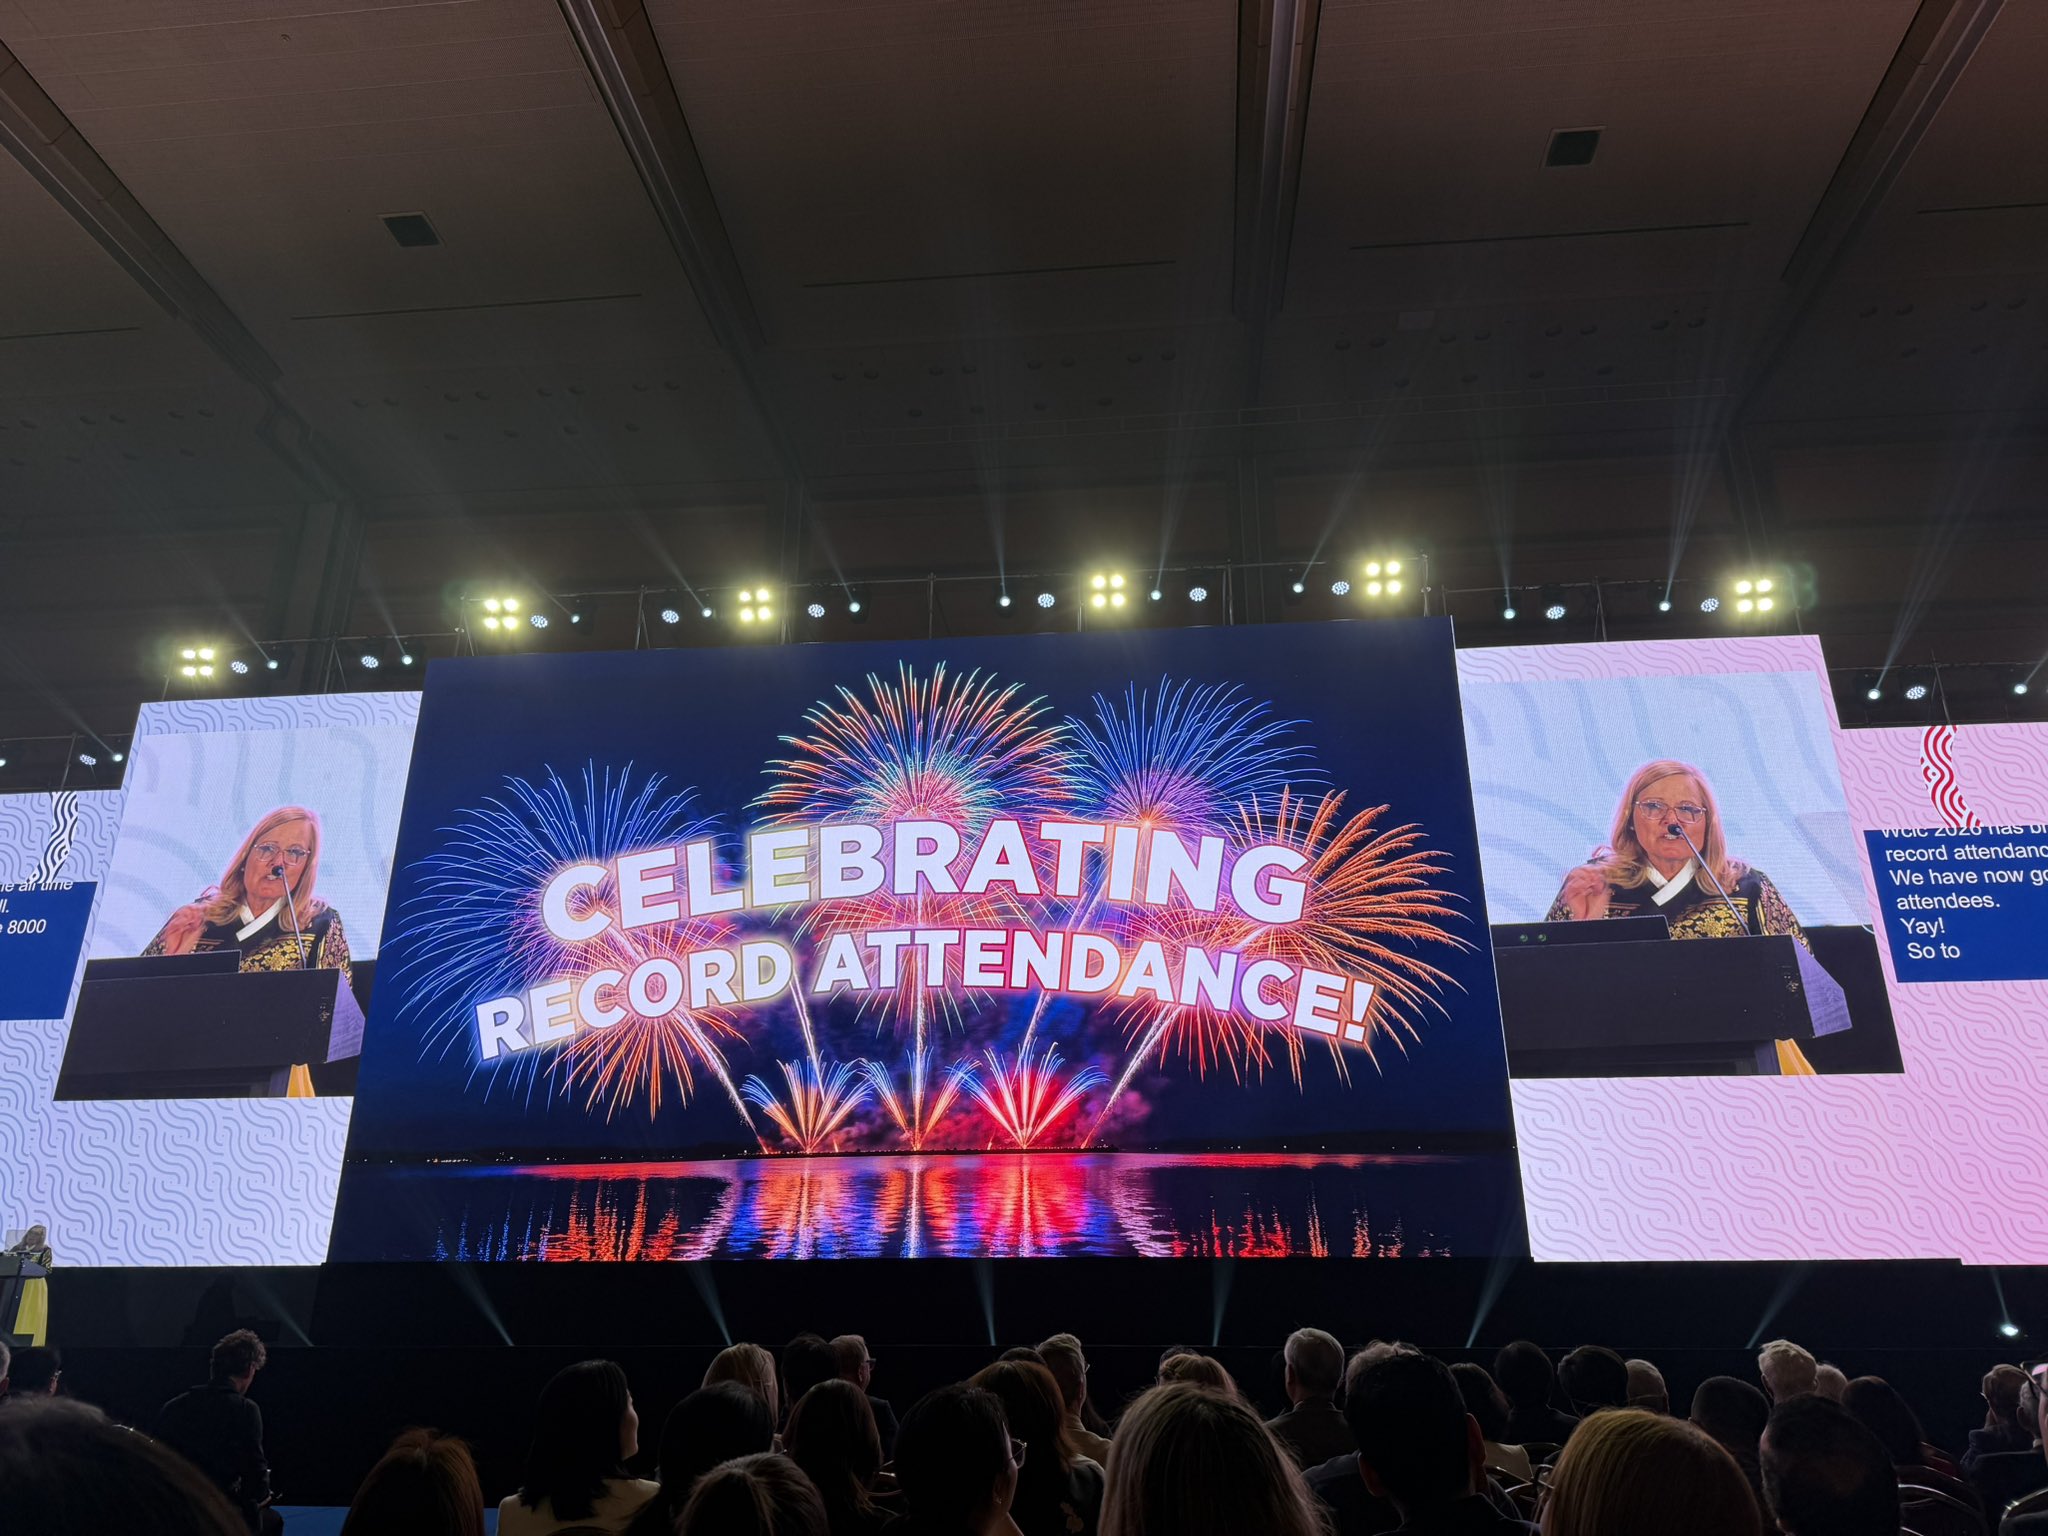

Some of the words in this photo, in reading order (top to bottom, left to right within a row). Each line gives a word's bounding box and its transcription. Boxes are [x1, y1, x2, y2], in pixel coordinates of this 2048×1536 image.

[1885, 844, 1948, 862] record
[541, 819, 1308, 941] CELEBRATING
[1889, 869, 1924, 886] We
[1929, 868, 1978, 885] have
[1983, 870, 2024, 883] now
[1896, 893, 2001, 910] attendees.
[7, 918, 47, 934] 8000
[1900, 917, 1946, 938] Yay!
[1907, 943, 1935, 959] So
[1940, 943, 1960, 958] to
[475, 939, 794, 1061] RECORD
[812, 928, 1376, 1044] ATTENDANCE!
